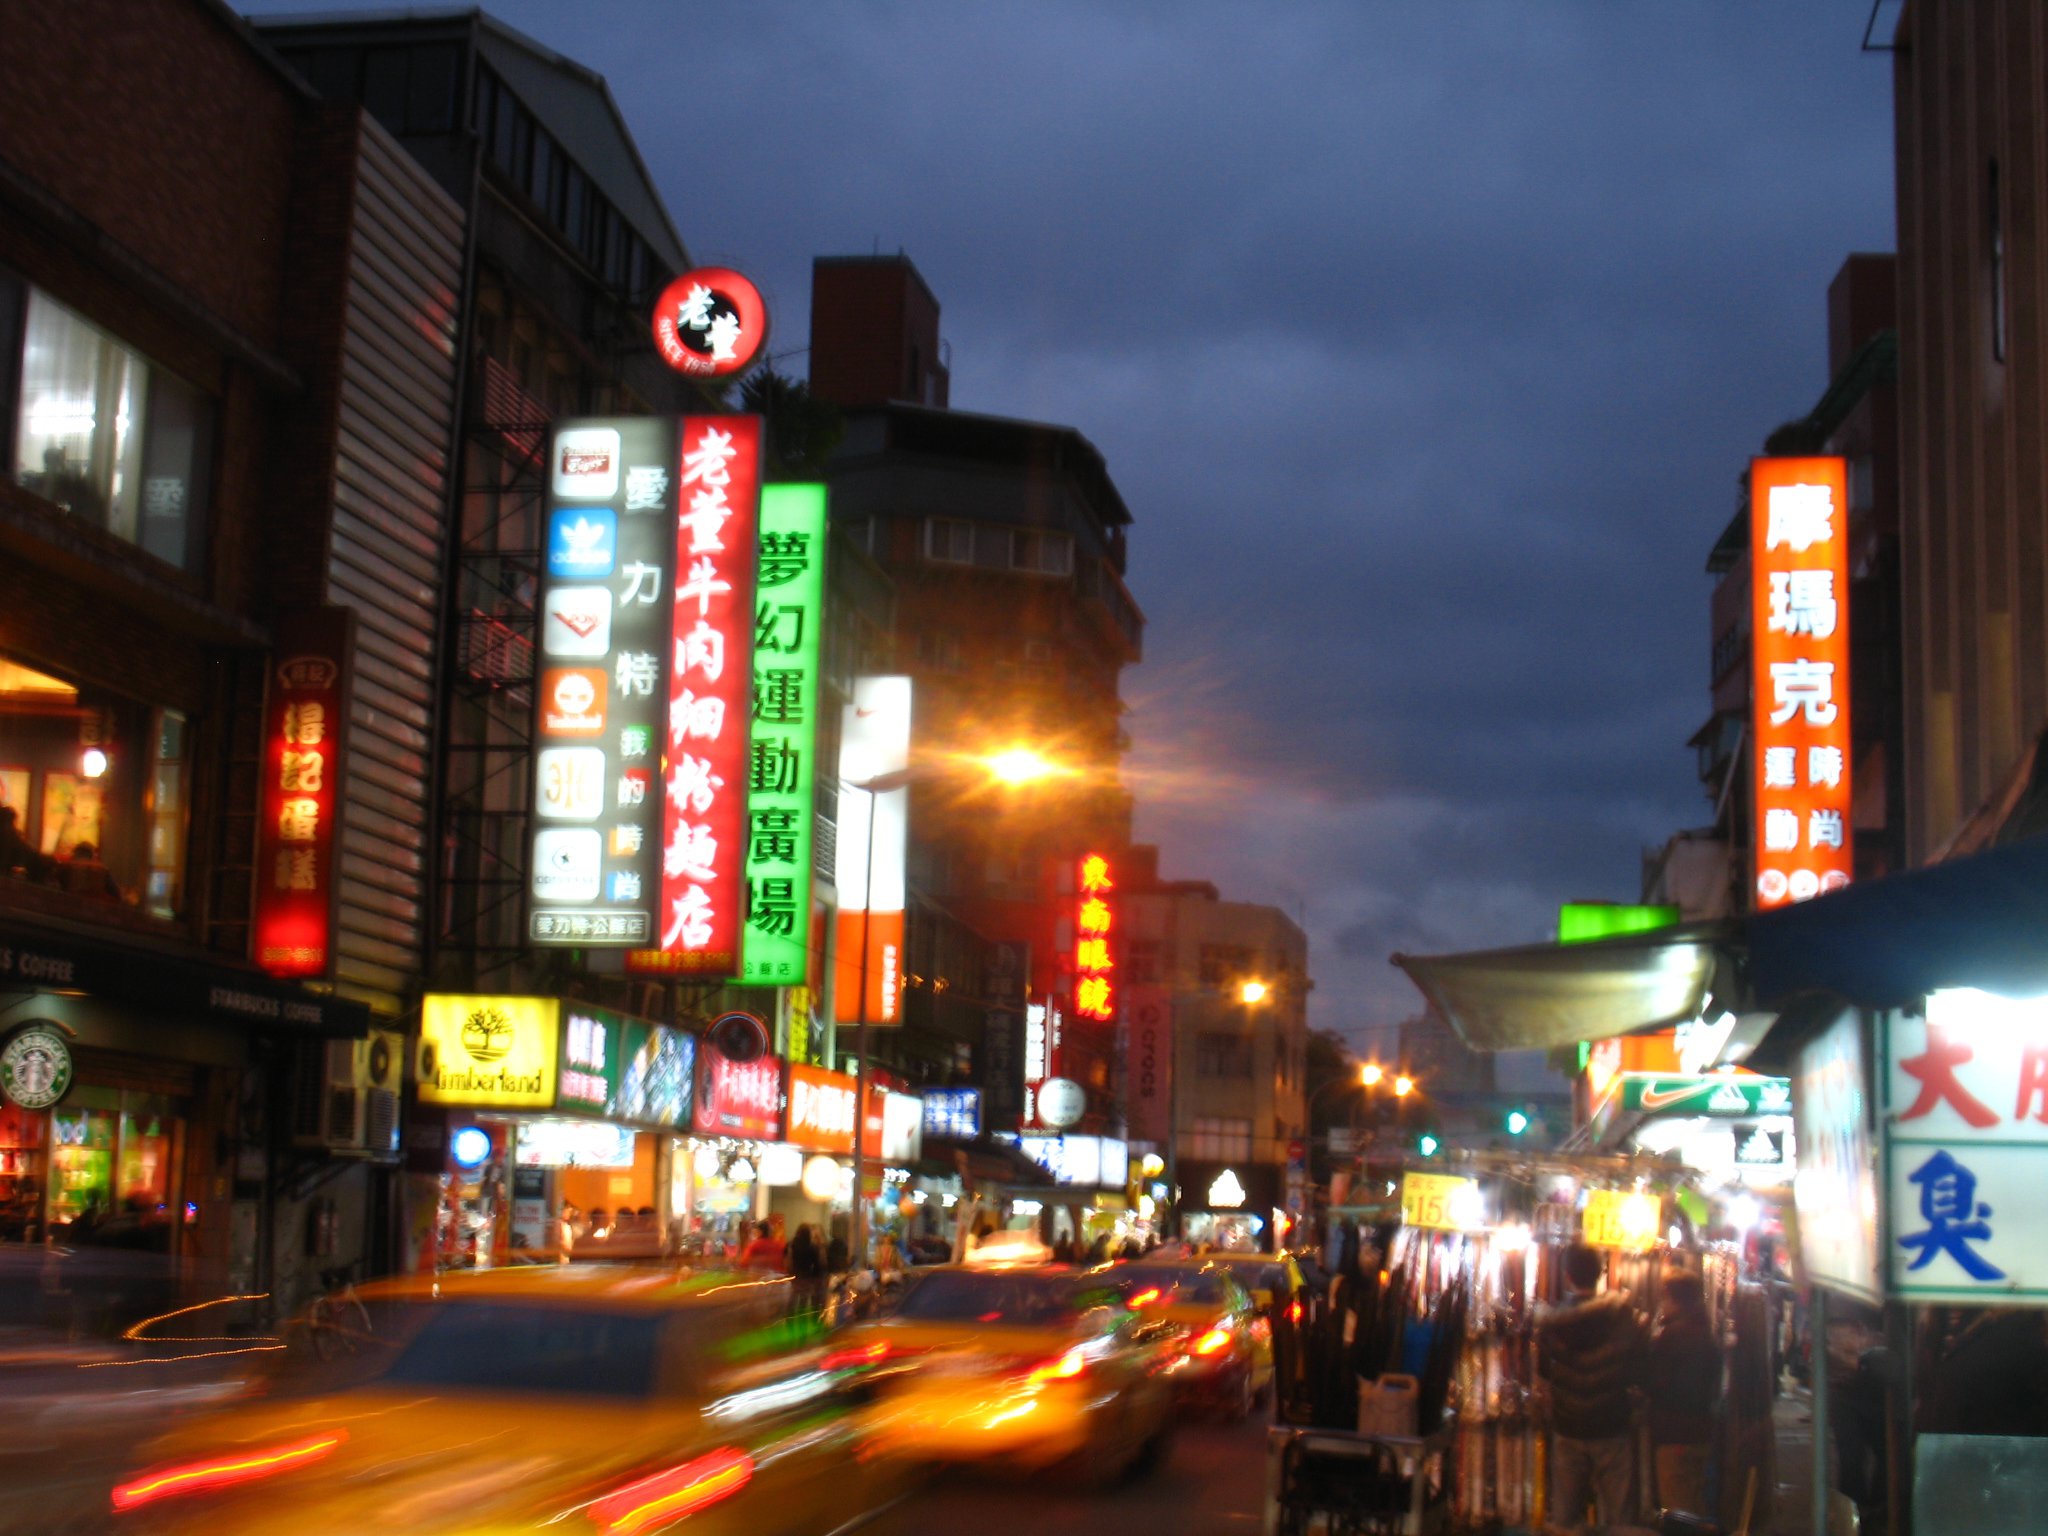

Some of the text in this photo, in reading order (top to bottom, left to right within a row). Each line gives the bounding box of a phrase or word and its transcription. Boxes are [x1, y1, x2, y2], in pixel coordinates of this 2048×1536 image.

[677, 281, 742, 360] 老董
[616, 465, 669, 697] 愛力特
[746, 530, 811, 938] 夢幻運動廣場
[18, 950, 76, 984] COFFEE
[208, 987, 323, 1024] STARBUCKS COFFEE
[1139, 1028, 1157, 1098] crocs
[1896, 1149, 2007, 1282] 臭
